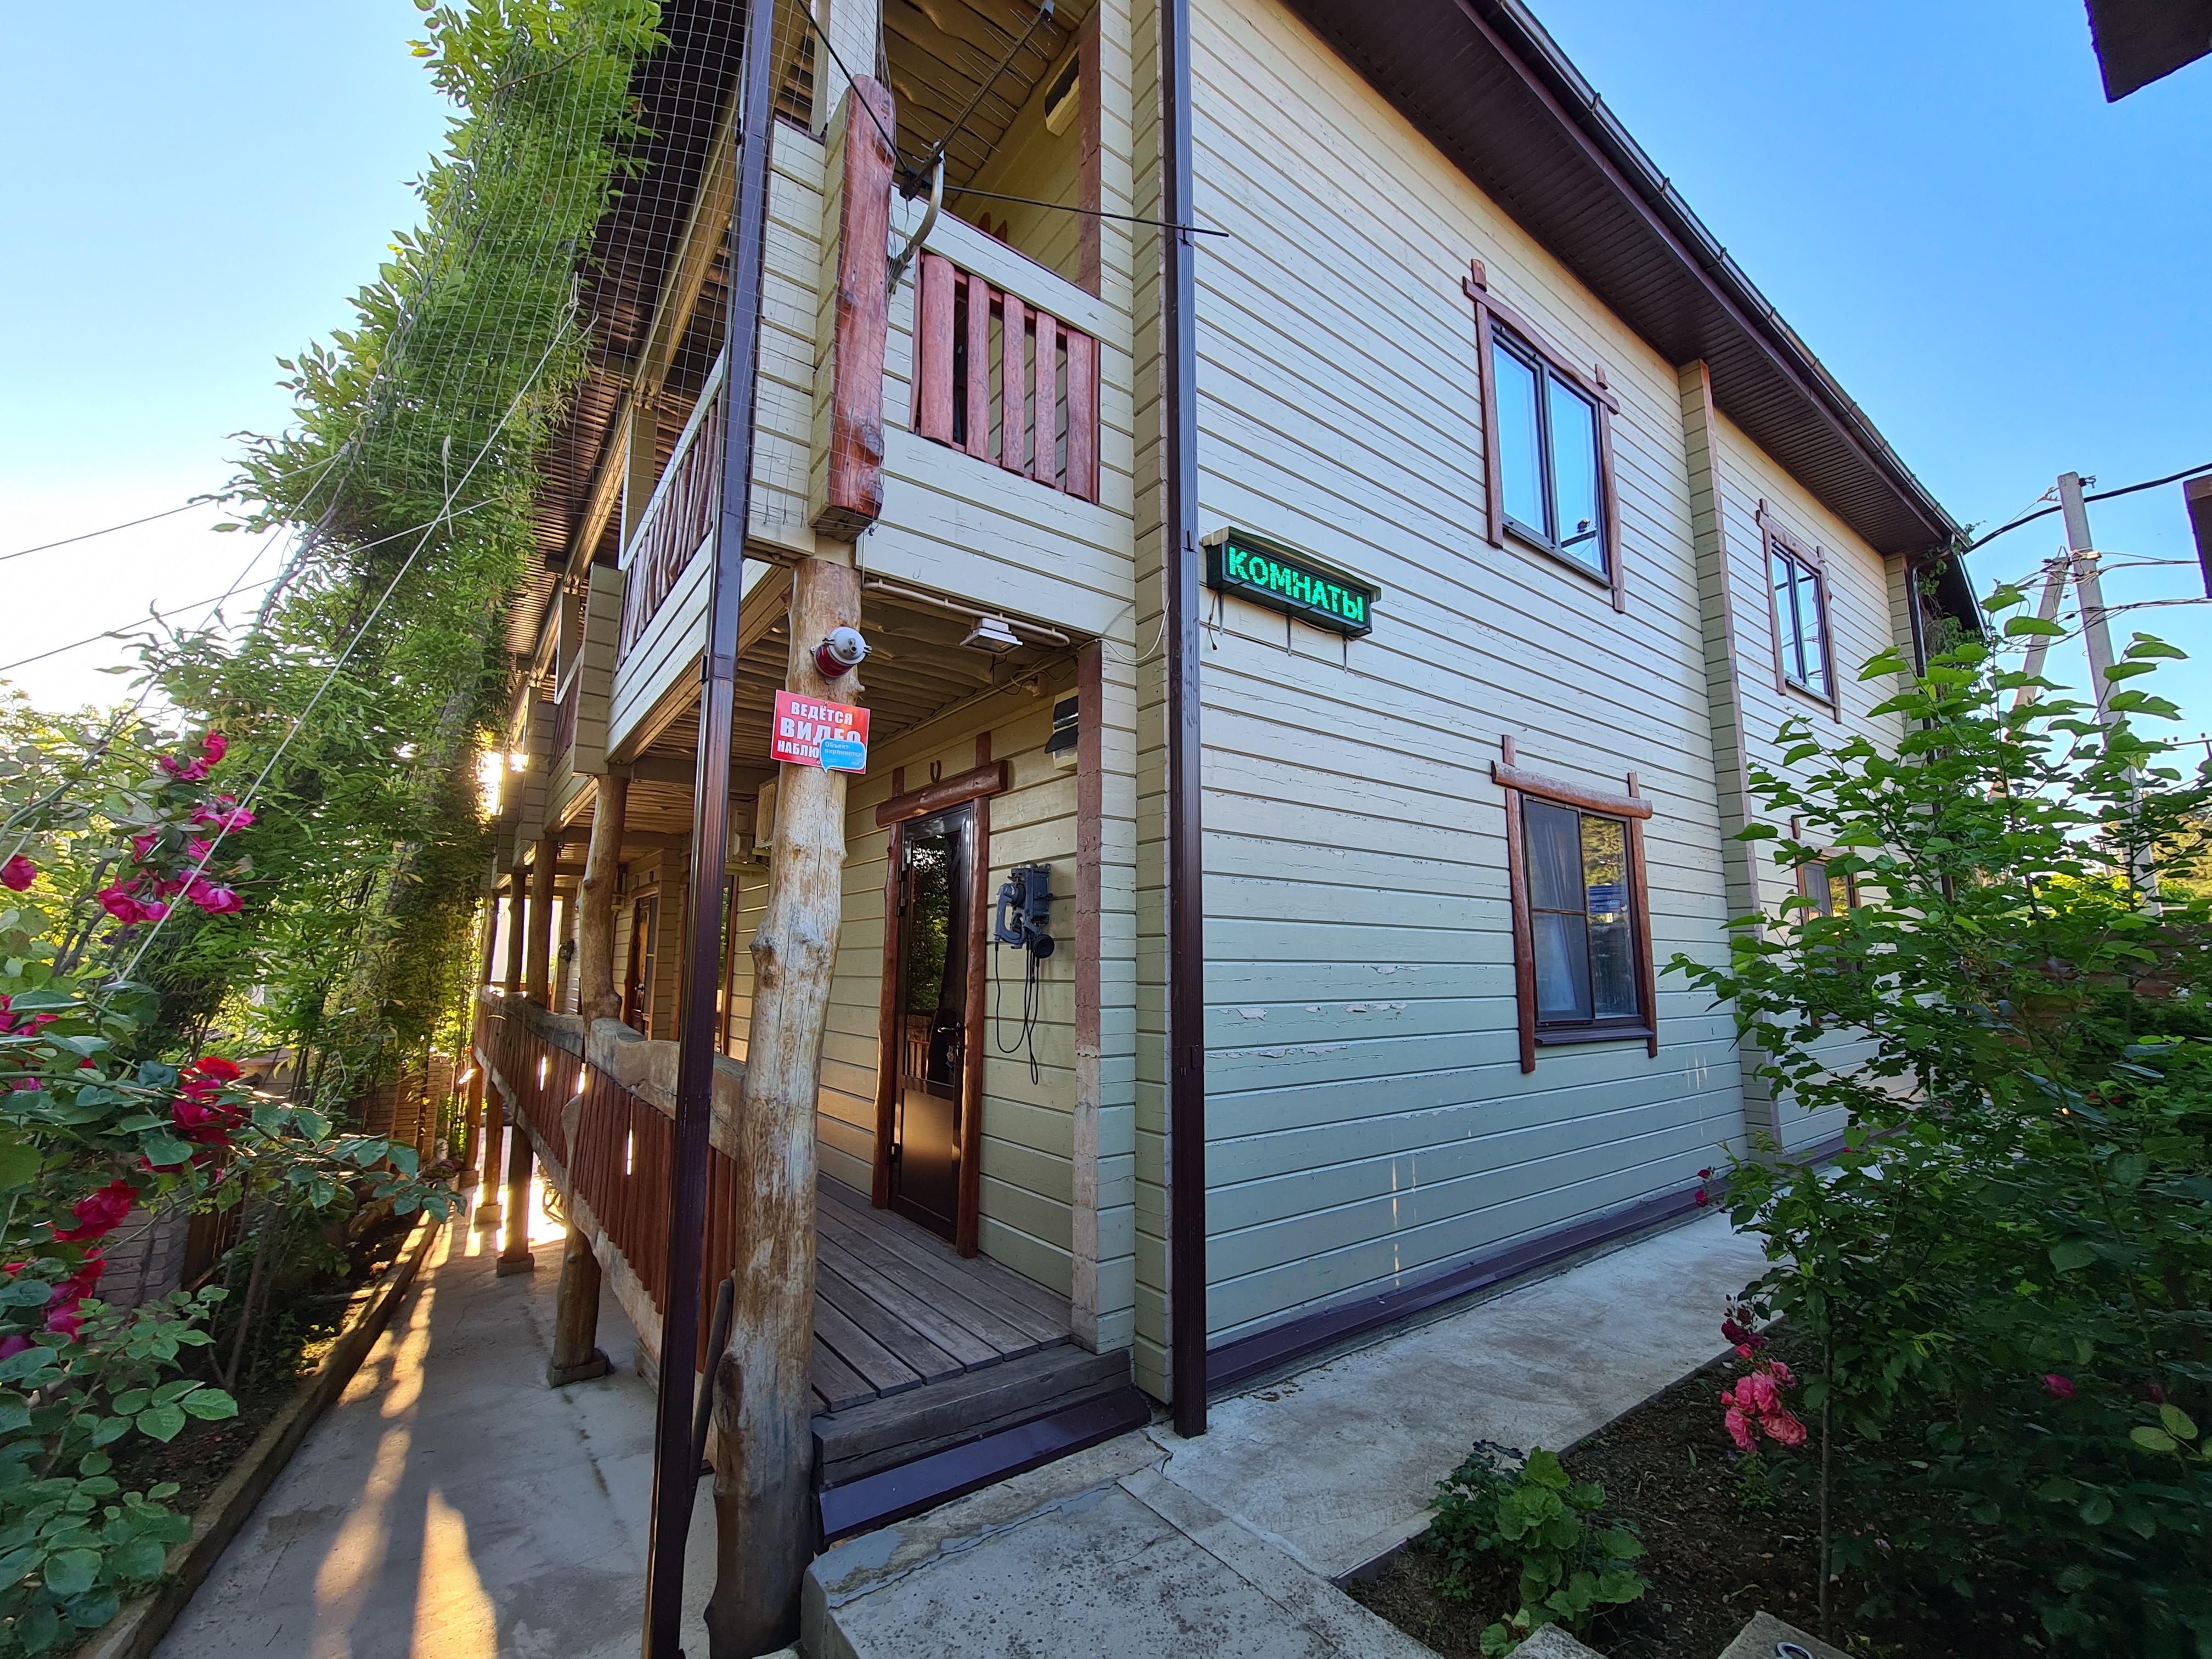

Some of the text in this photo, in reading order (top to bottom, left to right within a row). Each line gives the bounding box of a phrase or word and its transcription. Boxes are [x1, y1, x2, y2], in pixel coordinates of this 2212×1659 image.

[1229, 546, 1363, 622] КОМНАТЫ
[791, 701, 853, 726] ВЕДЁТСЯ
[777, 740, 820, 759] НАБЛЮ
[825, 748, 862, 757] охраняется
